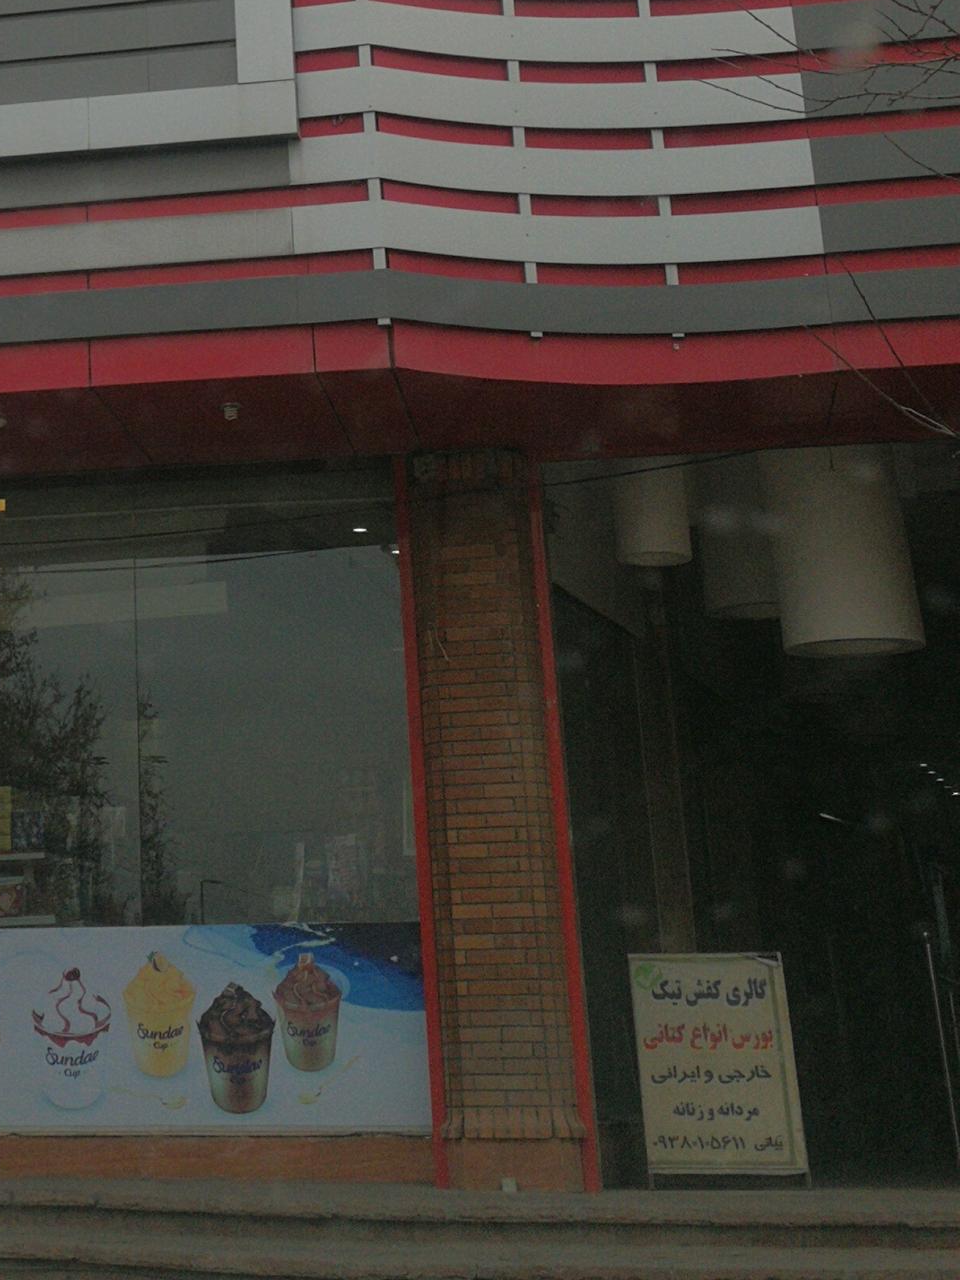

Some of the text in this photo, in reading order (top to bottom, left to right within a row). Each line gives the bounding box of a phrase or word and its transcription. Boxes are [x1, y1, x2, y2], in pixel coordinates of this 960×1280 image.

[686, 979, 721, 1007] کفش
[726, 977, 767, 1007] گالری
[137, 1023, 184, 1041] Sundae
[643, 1023, 774, 1051] بورس انواع کتانی
[45, 1047, 100, 1067] Sundae
[651, 1065, 773, 1084] خارجی و ایرانی
[672, 1101, 704, 1121] زنانه
[717, 1102, 759, 1121] مردانه
